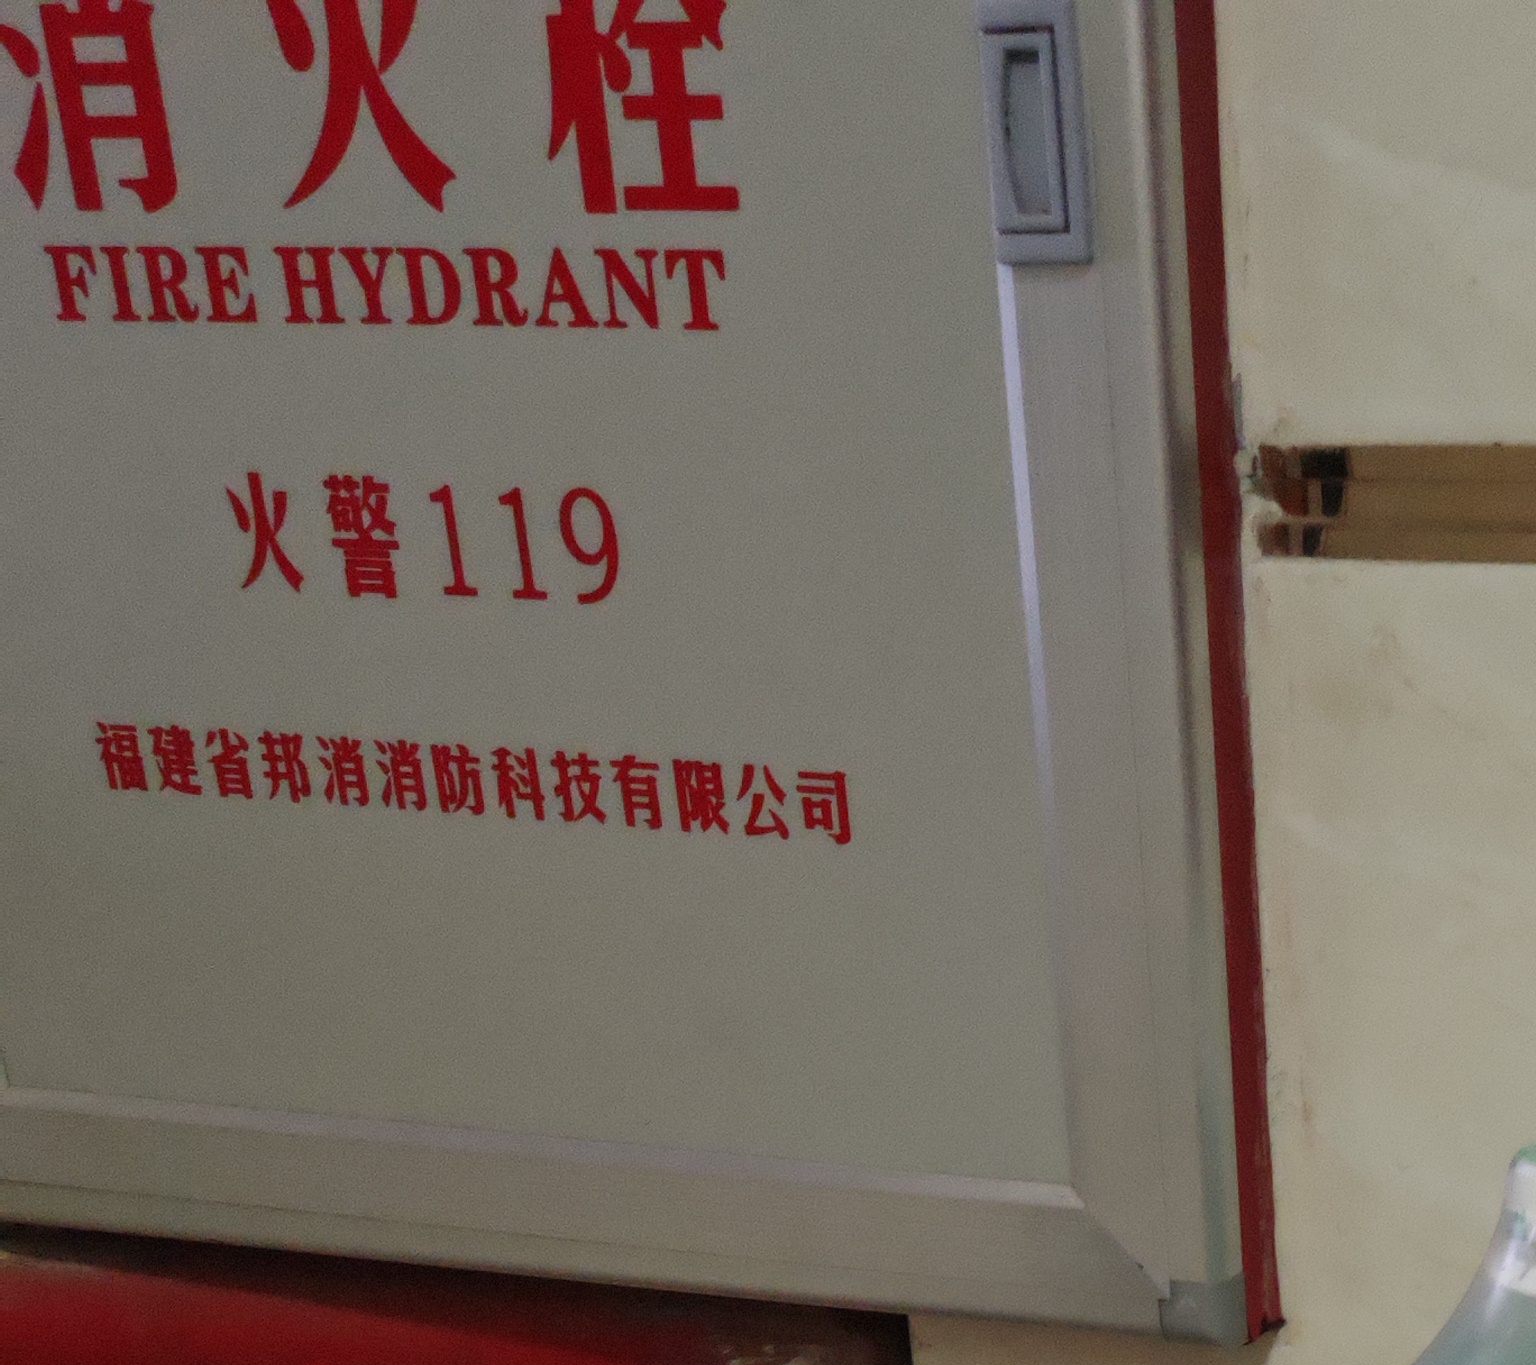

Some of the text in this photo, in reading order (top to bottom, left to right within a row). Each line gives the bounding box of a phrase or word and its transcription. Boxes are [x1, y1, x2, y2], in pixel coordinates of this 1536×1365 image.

[0, 0, 740, 214] 消火栓
[43, 245, 727, 331] FIRE HYDRANT
[225, 471, 620, 605] 火警119
[95, 720, 853, 845] 福建省邦消消防科技有限公司
